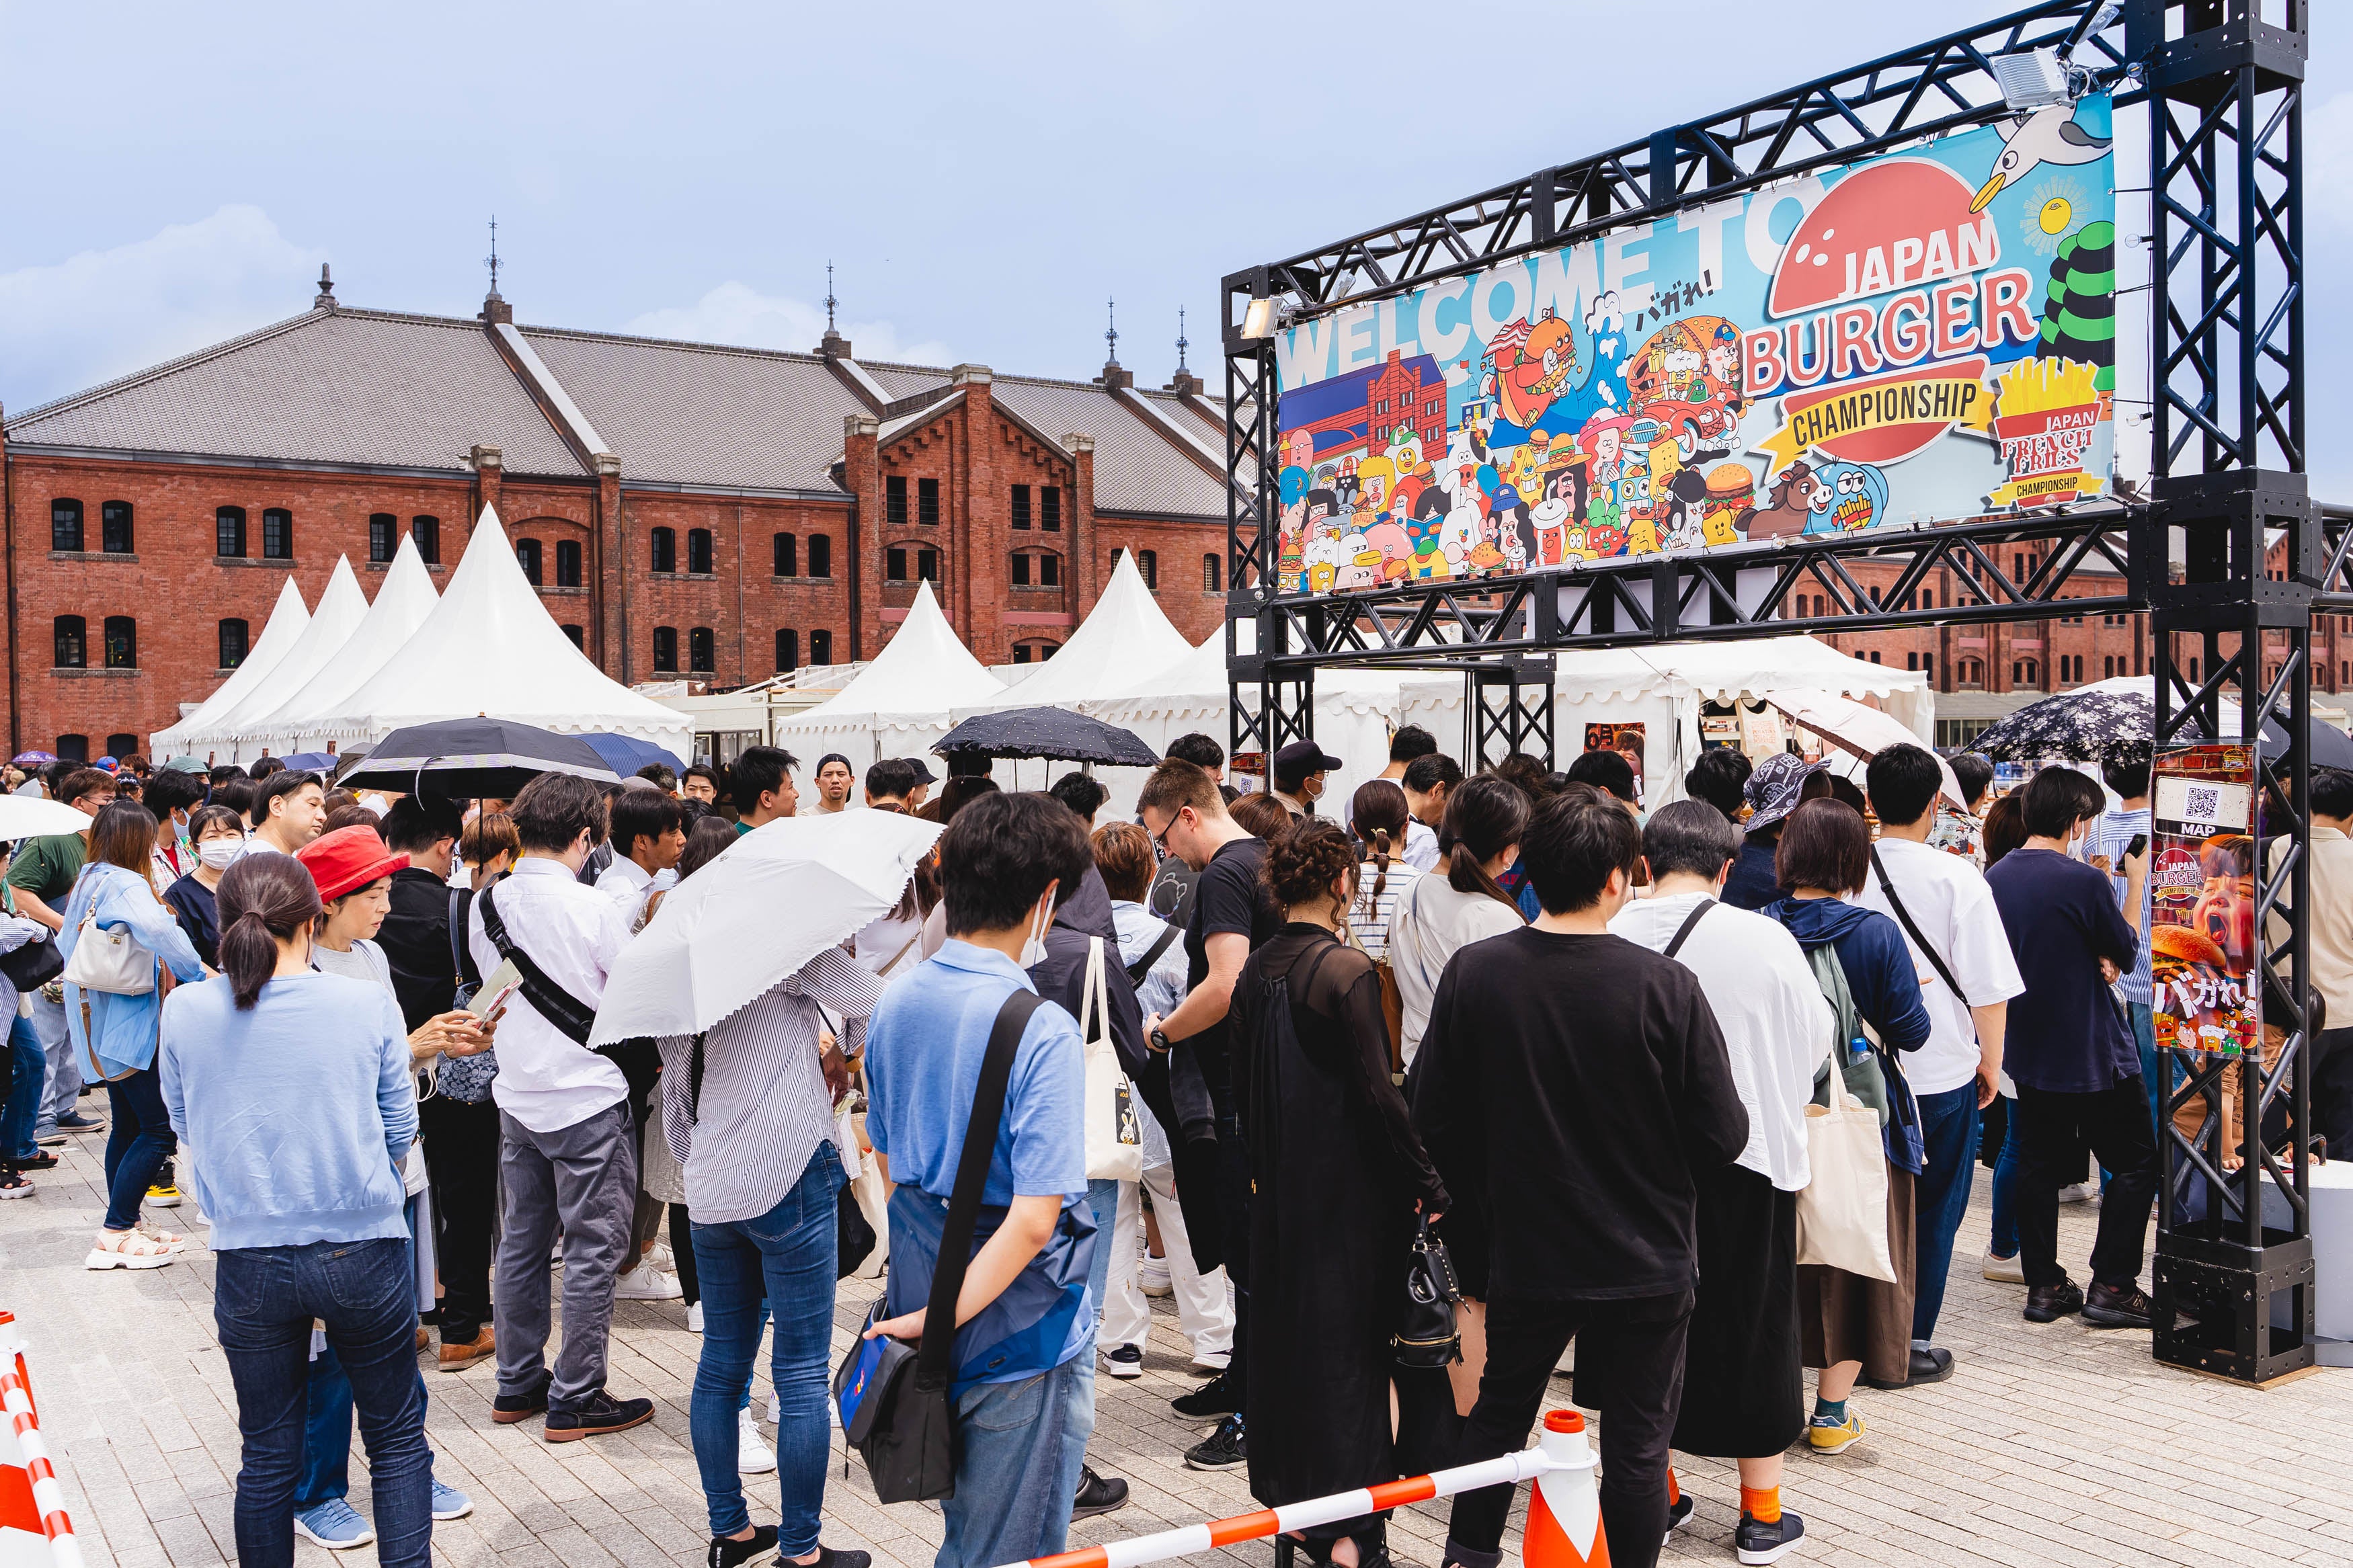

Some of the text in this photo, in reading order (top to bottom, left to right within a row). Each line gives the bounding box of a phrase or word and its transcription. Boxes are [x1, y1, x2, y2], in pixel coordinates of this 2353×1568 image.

[1838, 214, 1995, 300] JAPAN
[1275, 176, 1827, 392] WELCOME TO
[1744, 270, 2038, 395] BURGER
[1792, 382, 1977, 446] CHAMPIONSHIP
[2044, 411, 2094, 433] JAPAN
[2001, 429, 2092, 458] FRENCH
[2014, 448, 2080, 473] FRIES
[2017, 477, 2078, 497] CHAMPIONSHIP
[1353, 513, 1373, 524] BURGER
[2181, 823, 2216, 837] MAP
[2151, 870, 2204, 885] BURGER
[2167, 862, 2198, 872] JAPAN
[2161, 887, 2196, 896] CHAMPIONSHIP
